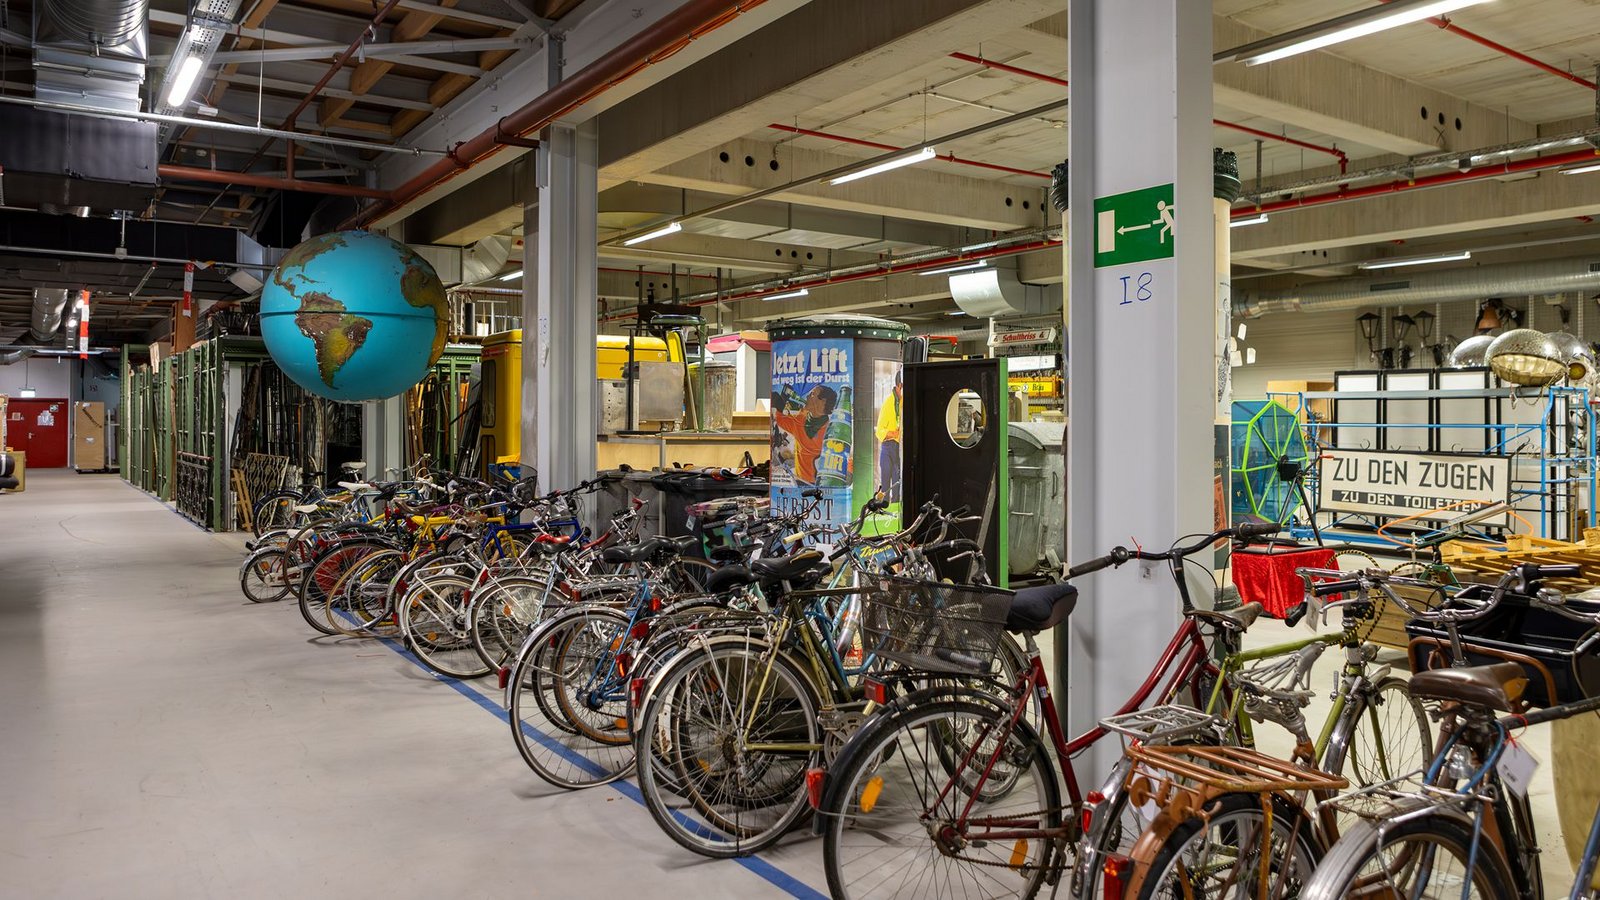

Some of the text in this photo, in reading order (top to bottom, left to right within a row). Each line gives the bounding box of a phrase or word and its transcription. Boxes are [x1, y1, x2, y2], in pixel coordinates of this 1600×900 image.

[810, 347, 848, 373] Lift
[780, 375, 795, 387] weg
[795, 373, 805, 384] ist
[805, 373, 823, 384] der
[824, 372, 850, 384] Durst
[1332, 457, 1495, 492] ZU DEN ZÜGEN
[1341, 490, 1482, 514] ZU DEN TOILETTEN
